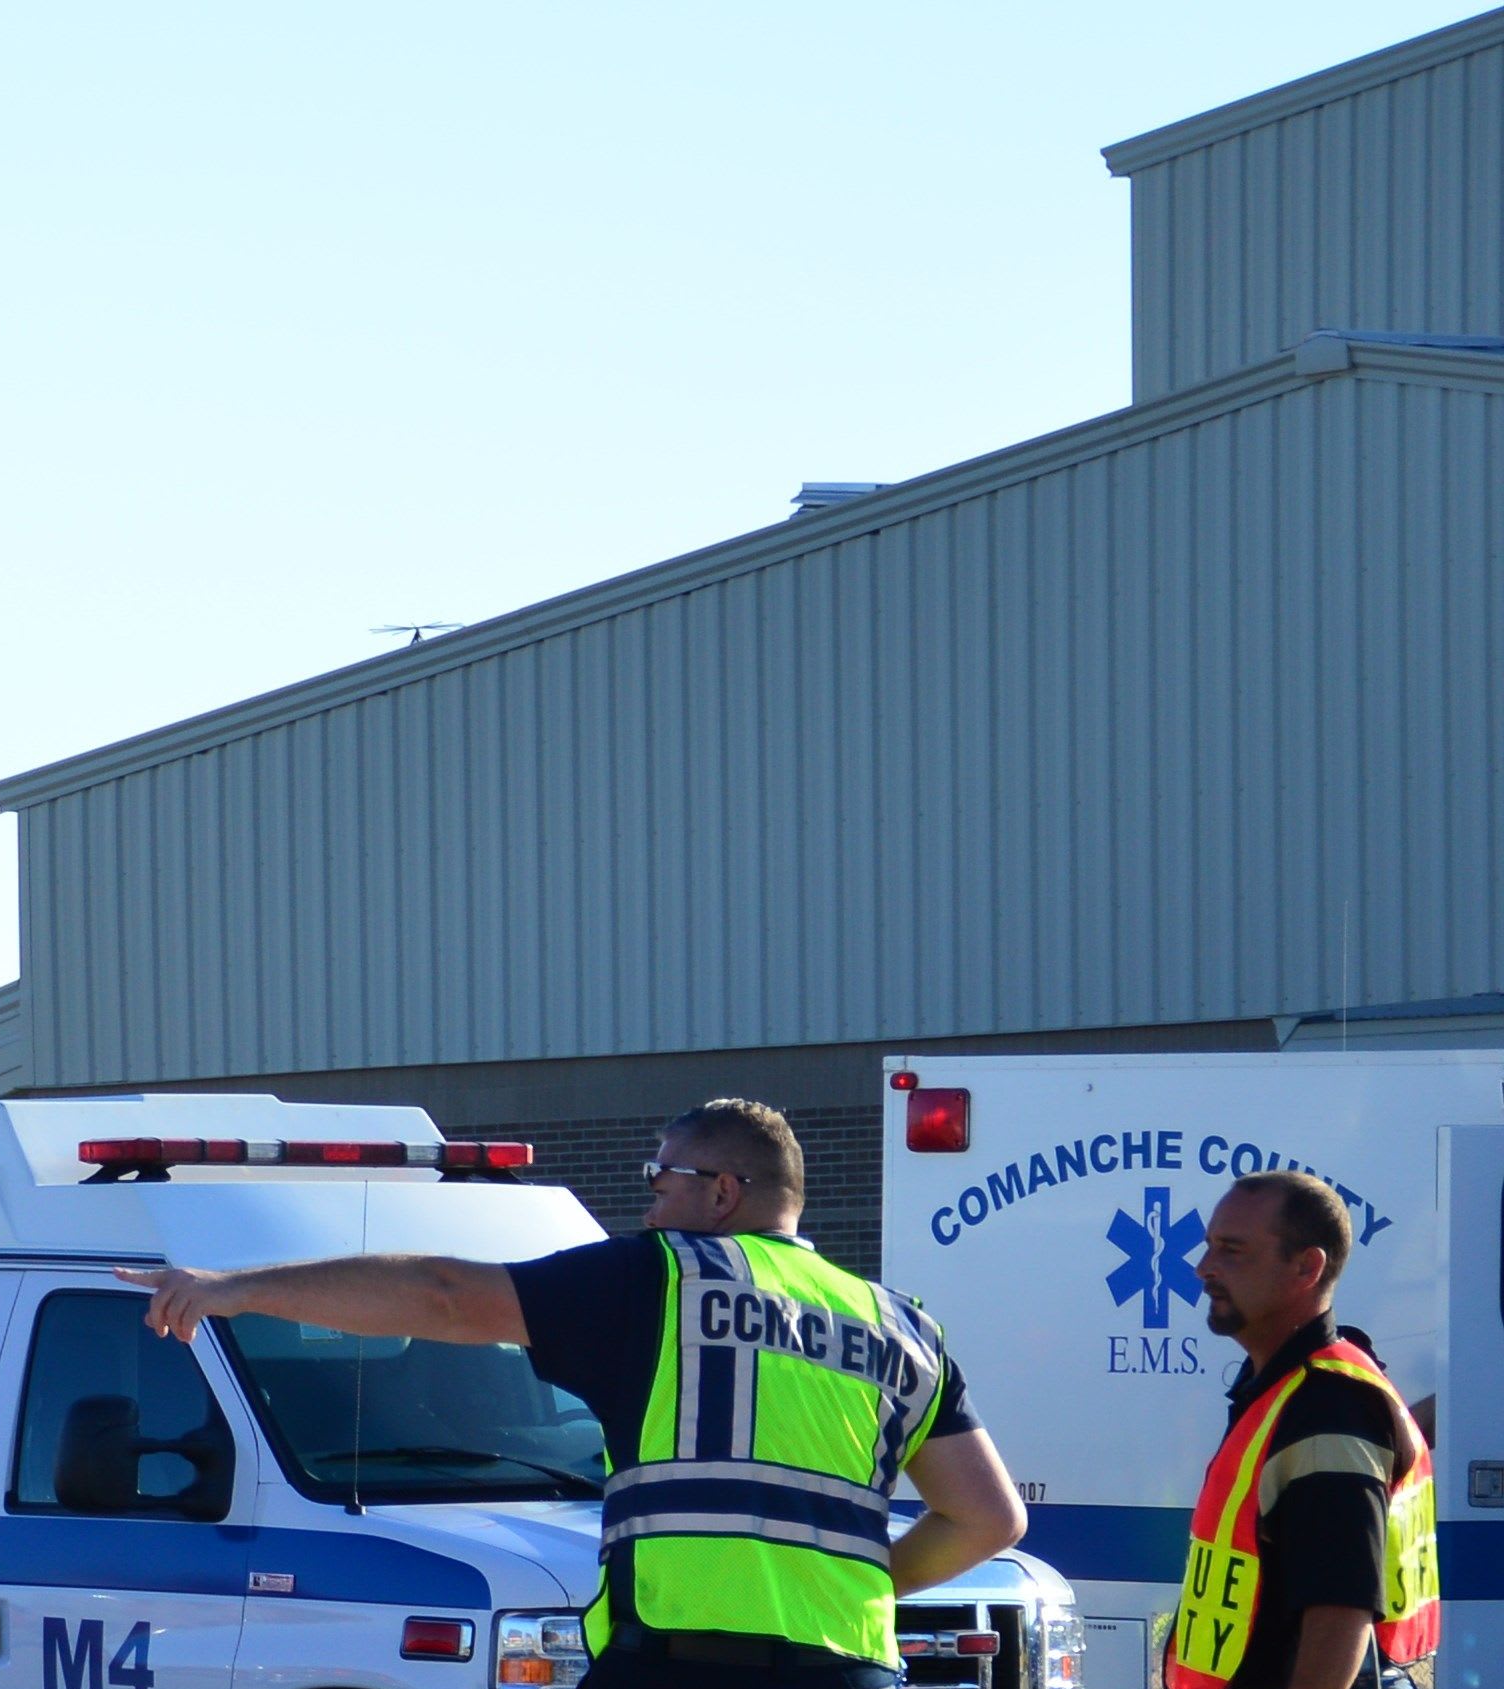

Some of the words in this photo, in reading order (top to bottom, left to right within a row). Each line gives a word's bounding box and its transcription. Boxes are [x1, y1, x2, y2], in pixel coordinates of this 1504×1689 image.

[930, 1130, 1184, 1246] COMANCHE
[1198, 1135, 1393, 1247] COTY
[1107, 1336, 1205, 1374] E.M.S.
[1018, 1482, 1046, 1502] 007
[1192, 1546, 1245, 1610] UE
[1182, 1608, 1235, 1672] TY
